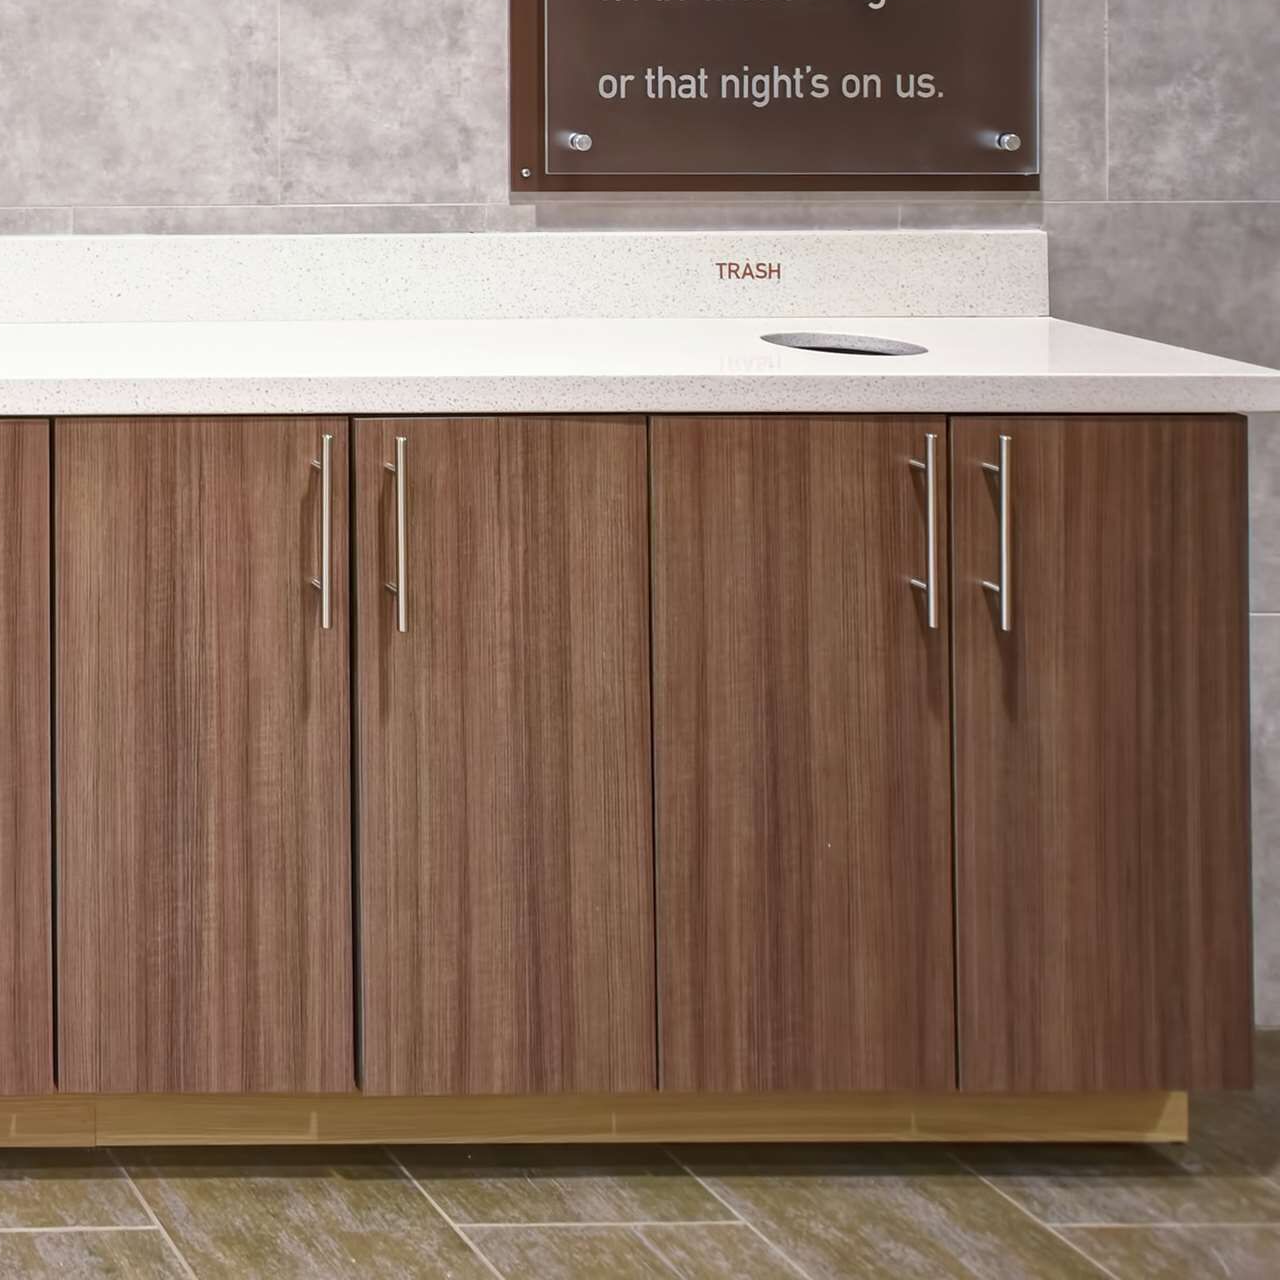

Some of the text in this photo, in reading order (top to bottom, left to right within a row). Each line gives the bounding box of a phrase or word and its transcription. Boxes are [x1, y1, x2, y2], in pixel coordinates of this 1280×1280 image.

[598, 65, 945, 108] or that night's on us.
[715, 262, 782, 280] TRASH
